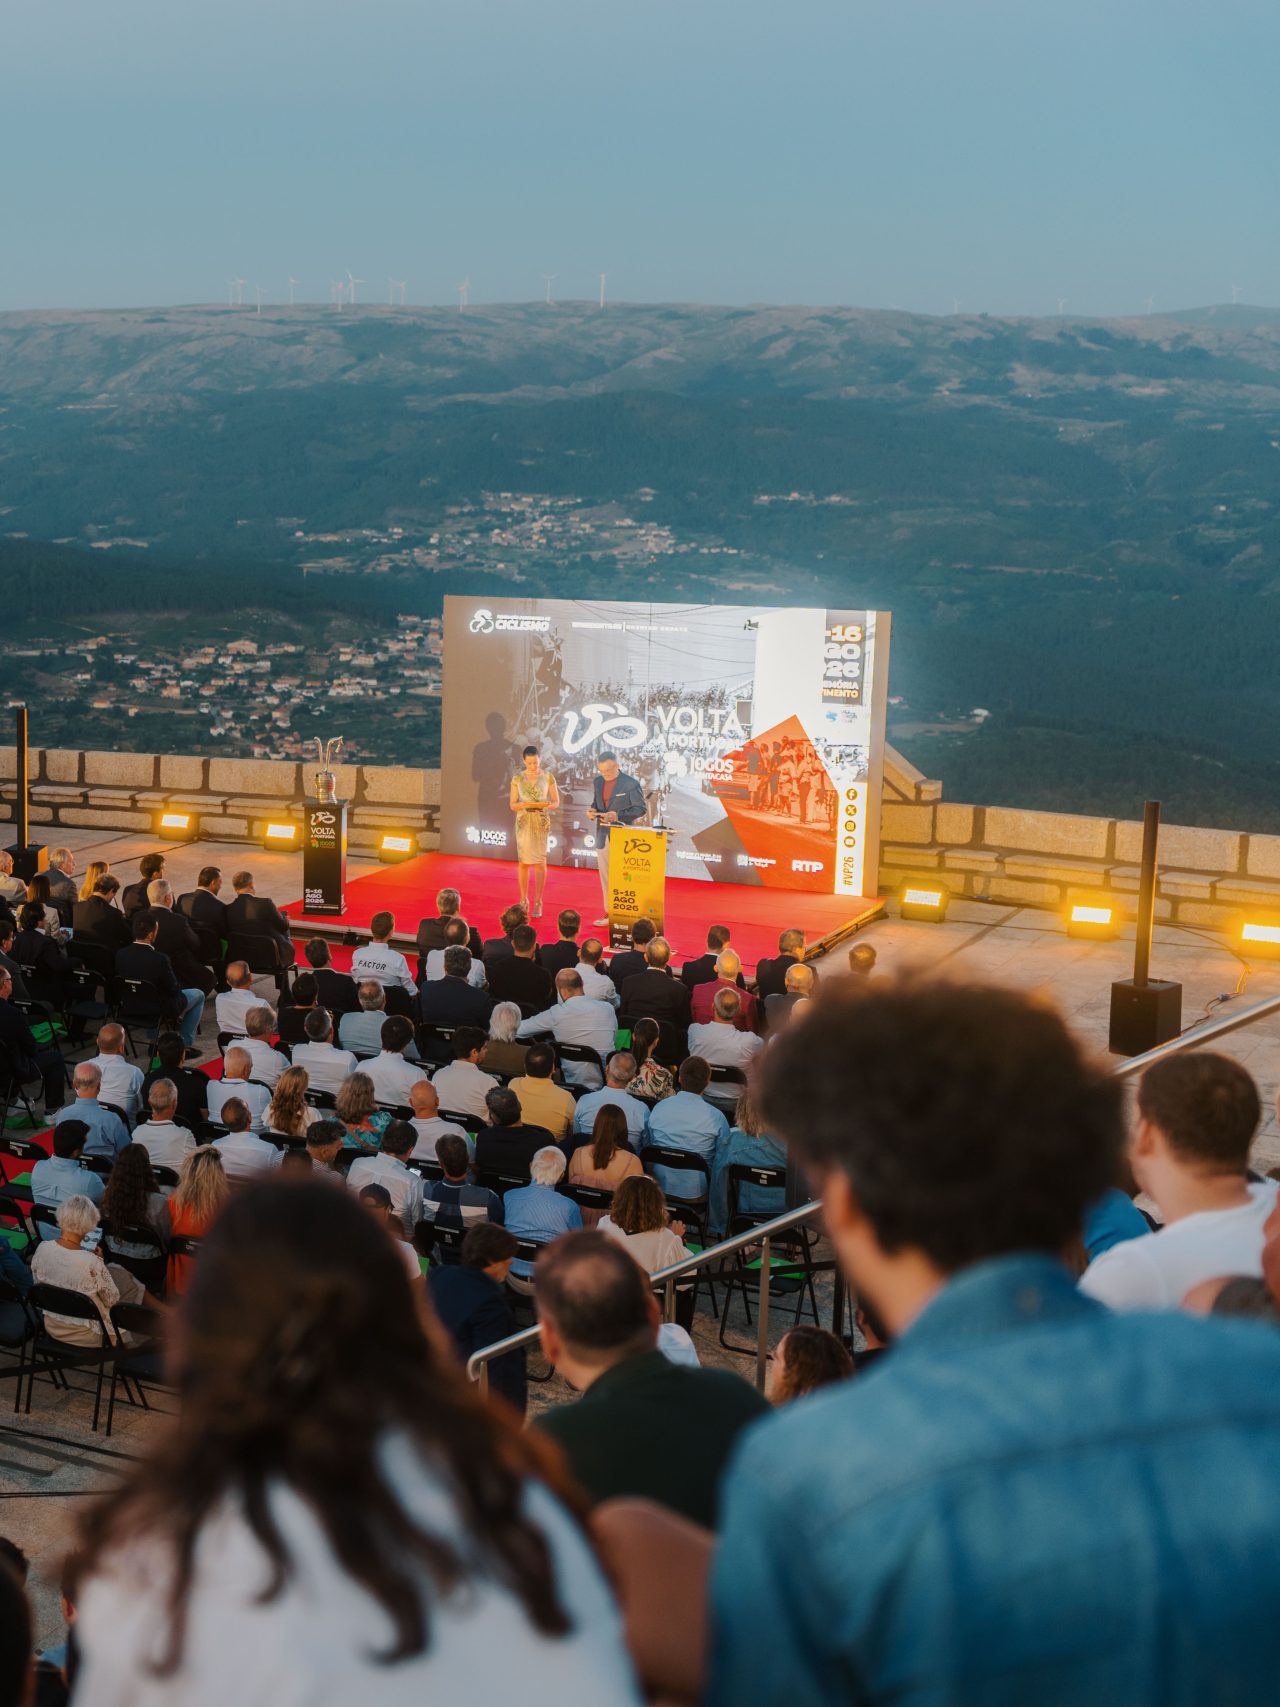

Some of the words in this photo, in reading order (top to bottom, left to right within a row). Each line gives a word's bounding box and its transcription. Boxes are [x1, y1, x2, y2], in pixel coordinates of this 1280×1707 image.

[495, 619, 550, 631] CICLISMO
[825, 625, 862, 642] -16
[823, 643, 861, 660] GO
[657, 706, 744, 735] VOLTA
[691, 757, 734, 774] JOGOS
[311, 827, 336, 835] VOLTA
[481, 830, 506, 842] JOGOS
[623, 857, 651, 867] VOLTA
[792, 859, 824, 873] RTP
[843, 856, 854, 886] #VP26
[613, 889, 636, 897] 5-16
[613, 896, 636, 904] AGO
[613, 903, 639, 912] 2026
[358, 960, 387, 971] FACTOR
